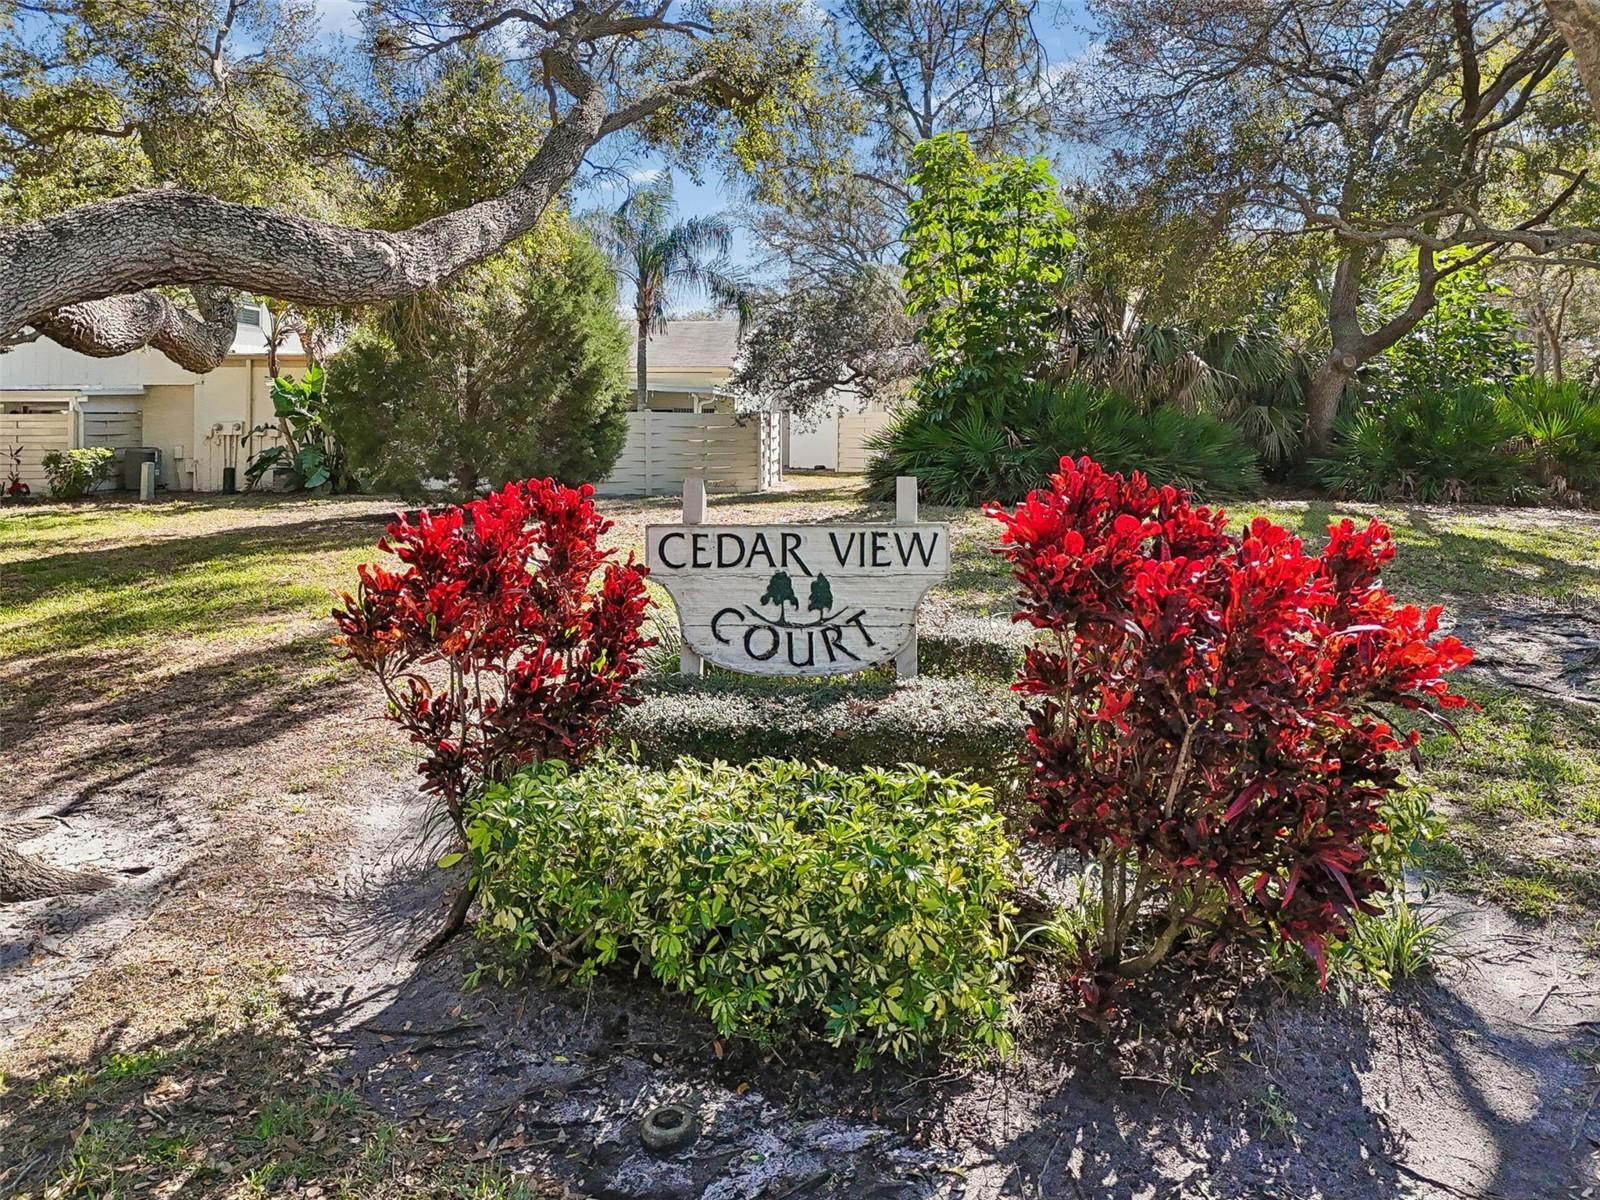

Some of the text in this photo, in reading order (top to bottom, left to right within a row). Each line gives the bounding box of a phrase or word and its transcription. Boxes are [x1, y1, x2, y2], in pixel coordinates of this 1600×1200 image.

[658, 531, 939, 577] CEDAR VIEW
[711, 607, 876, 667] COURT
